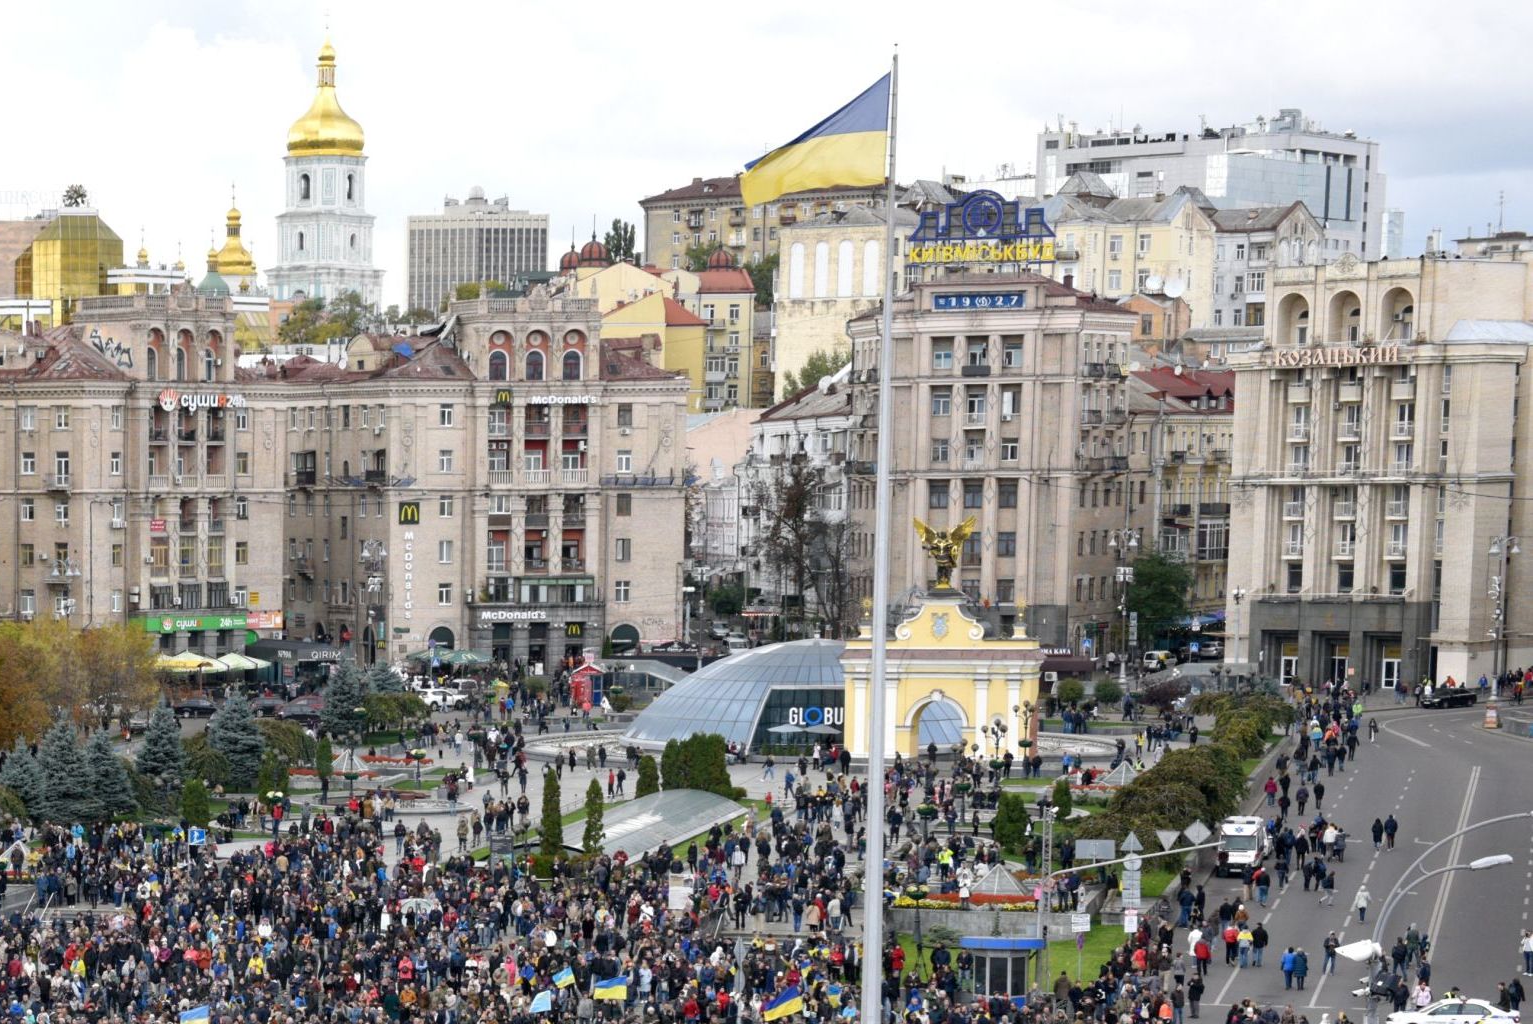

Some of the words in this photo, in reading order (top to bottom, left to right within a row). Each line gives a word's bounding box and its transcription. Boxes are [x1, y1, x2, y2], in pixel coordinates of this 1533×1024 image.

[909, 243, 1055, 262] КИЇВМІСЬКБУД
[1274, 345, 1399, 368] КОЗАЦЬКИЙ
[531, 395, 597, 404] McDonald's
[481, 611, 546, 619] McDonald's
[789, 706, 844, 726] GLOBU
